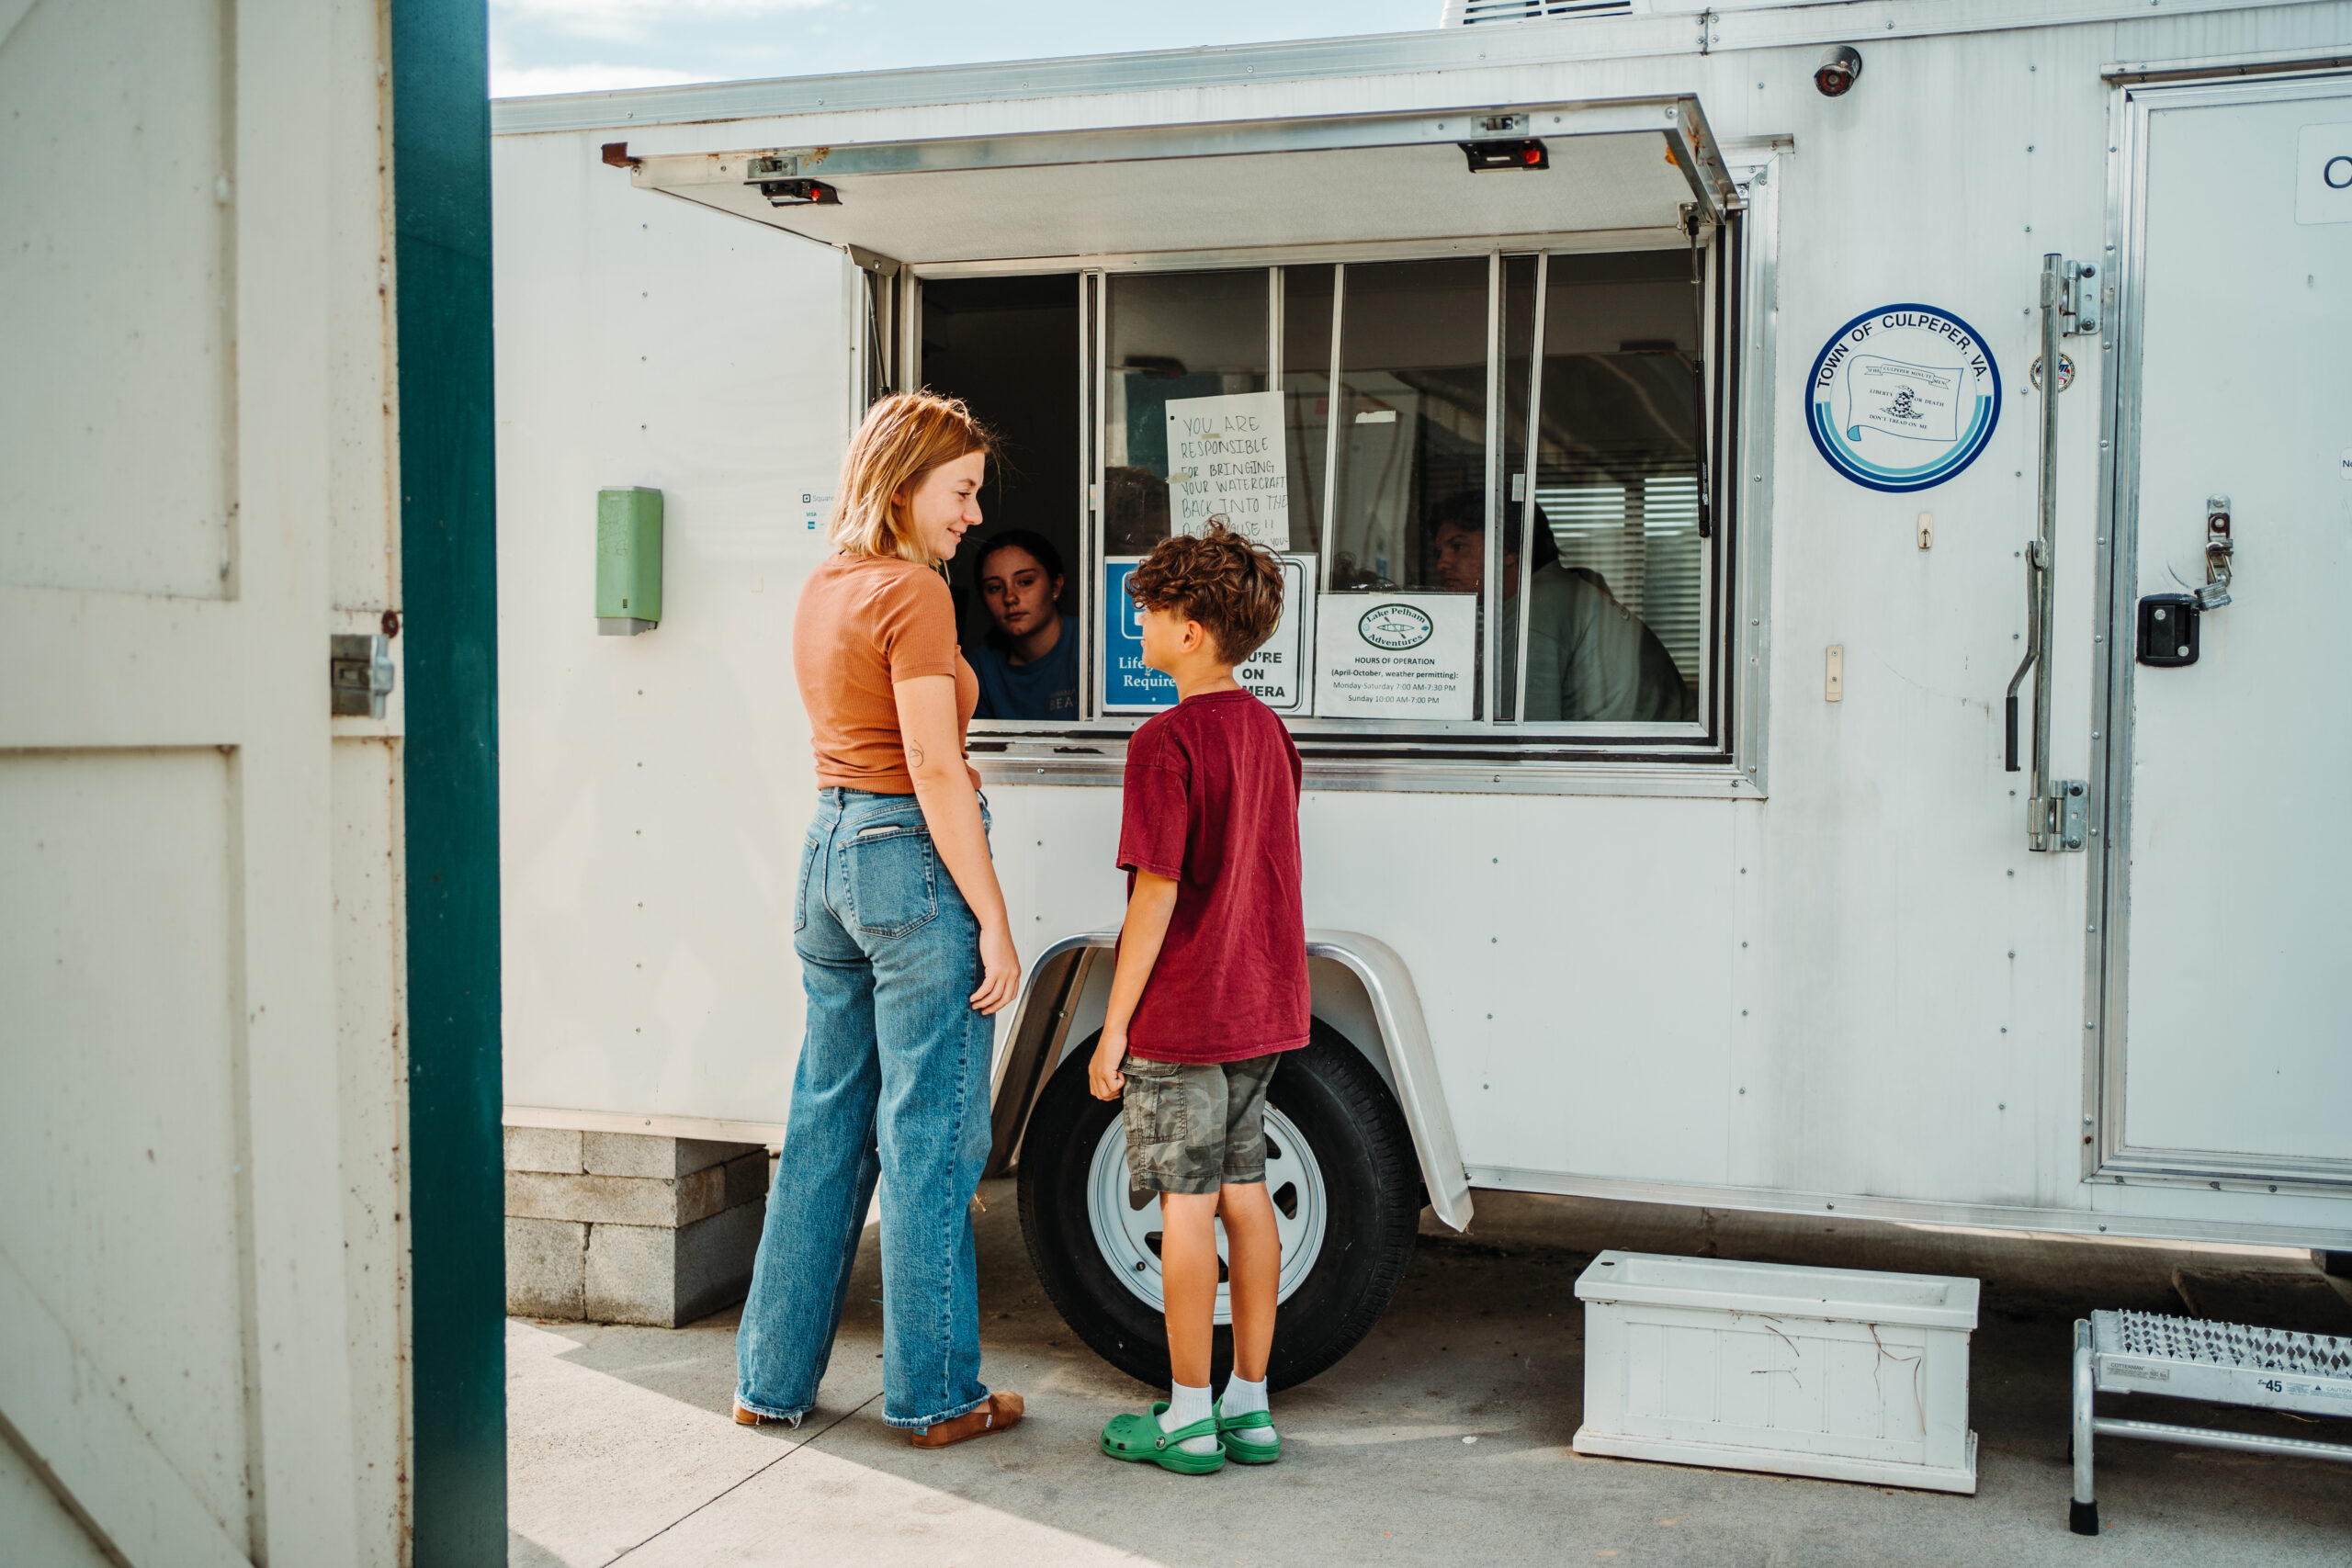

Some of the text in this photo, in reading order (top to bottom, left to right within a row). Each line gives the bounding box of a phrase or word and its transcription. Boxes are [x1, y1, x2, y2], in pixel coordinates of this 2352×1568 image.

[1817, 343, 1849, 389] TOWN
[1851, 321, 1873, 342] OF
[1883, 313, 1972, 355] CULPEPER,
[1971, 354, 1987, 382] VA.
[1883, 367, 1910, 375] CULPEPER
[1911, 370, 1932, 379] MINUTE
[1870, 389, 1894, 397] LIBERTY
[1924, 399, 1945, 407] DEATH
[1183, 415, 1260, 436] YOU ARE
[1181, 437, 1269, 458] RESPONSIBLE
[1181, 460, 1274, 478] FOR BRINGING
[1182, 477, 1286, 495] YOUR WATERCRAFT
[1182, 494, 1288, 518] BACK INTO THE
[1366, 607, 1426, 624] Lake Pelham
[1368, 633, 1423, 647] Adventures
[1248, 651, 1283, 663] U'RE
[1242, 669, 1264, 680] ON
[1416, 671, 1459, 680] permitting):
[1124, 674, 1176, 691] Require
[1412, 683, 1443, 692] AM-7:30
[1242, 685, 1285, 697] MERA
[1348, 694, 1374, 704] Sunday
[2266, 1380, 2282, 1393] 45
